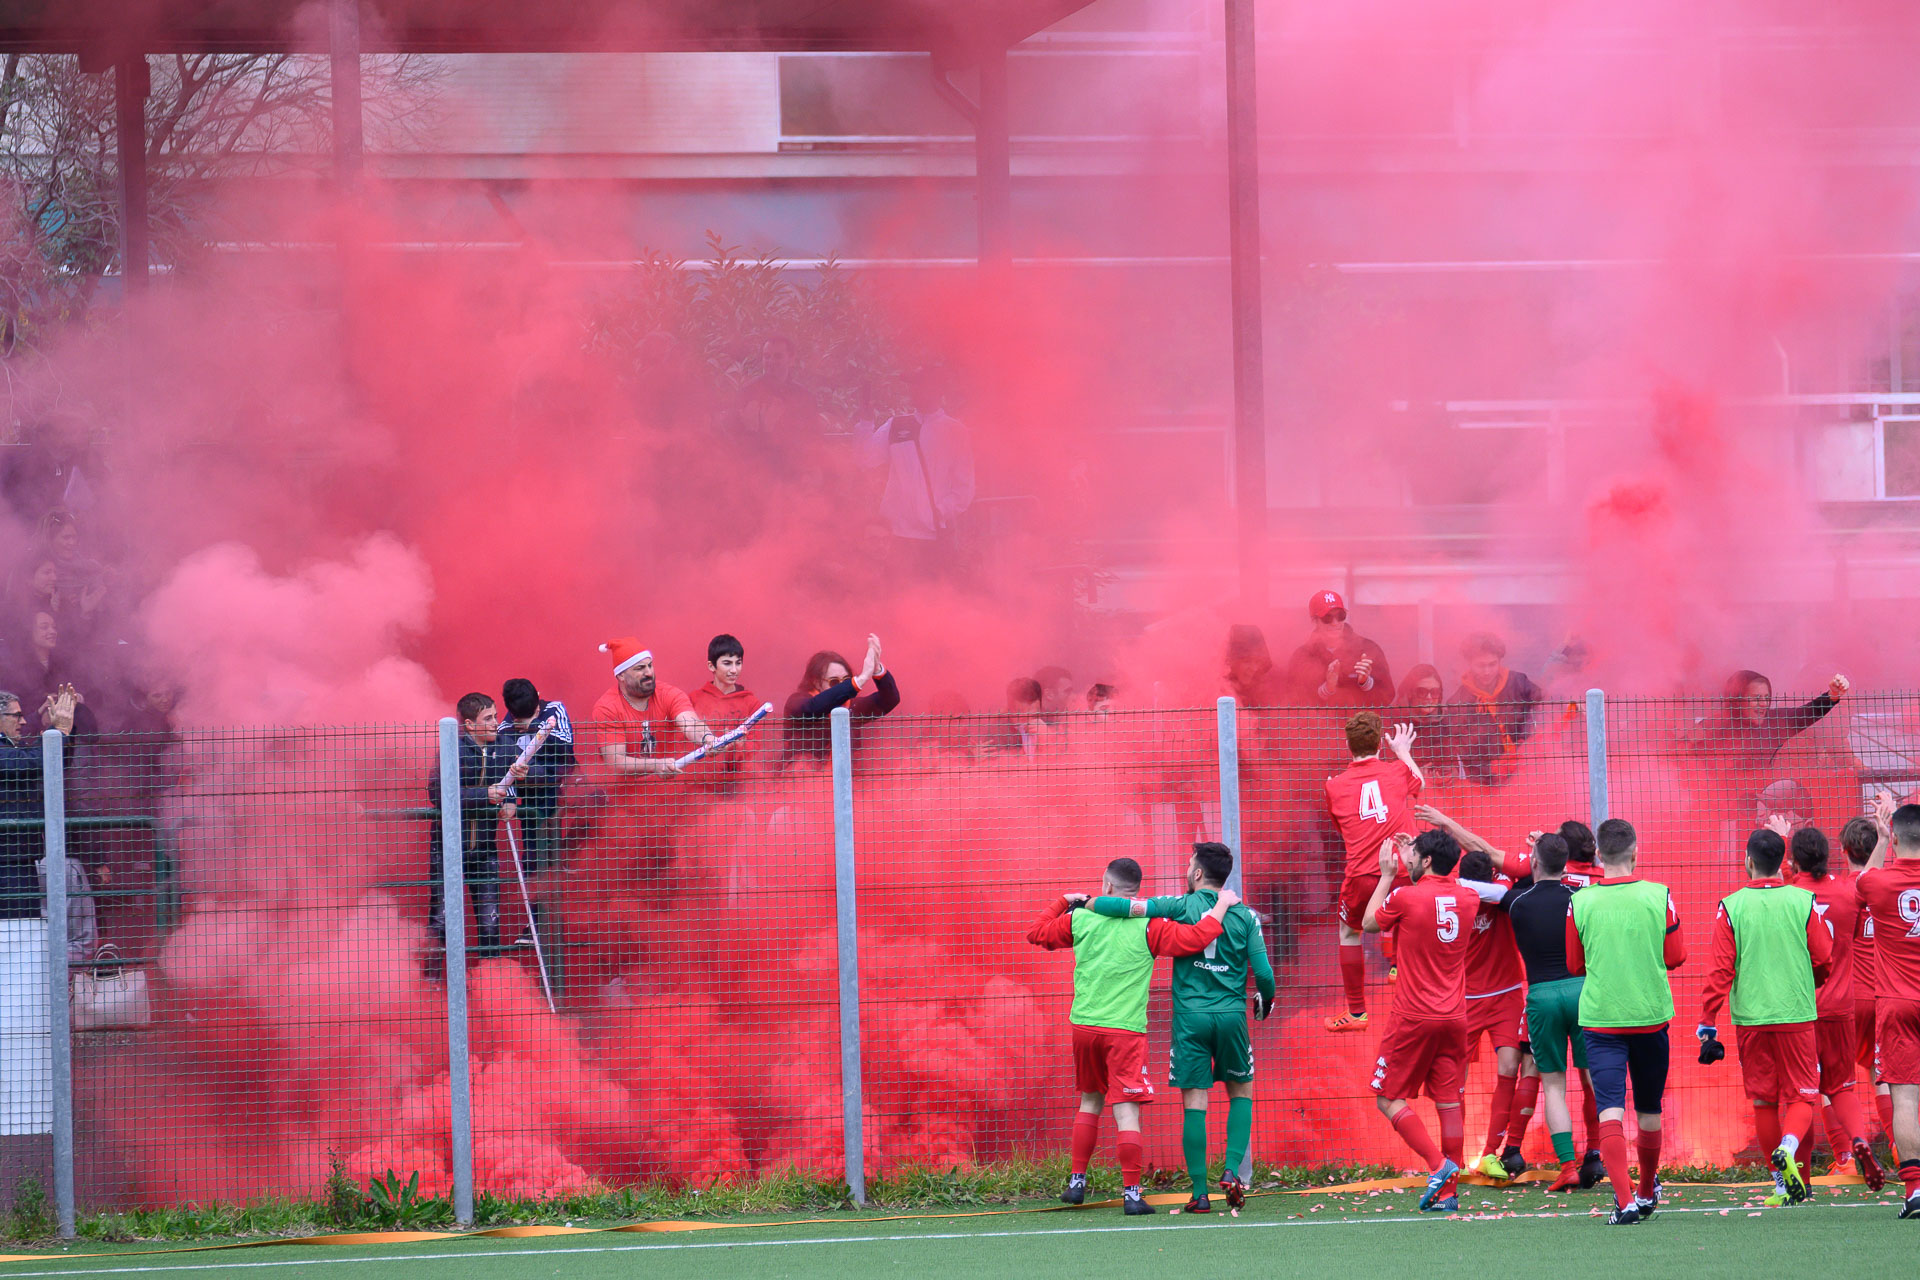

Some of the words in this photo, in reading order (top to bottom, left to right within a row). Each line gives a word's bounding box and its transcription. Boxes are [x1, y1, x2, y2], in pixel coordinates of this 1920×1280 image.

[1359, 780, 1388, 824] 4
[1435, 896, 1459, 943] 5
[1898, 889, 1920, 937] 9
